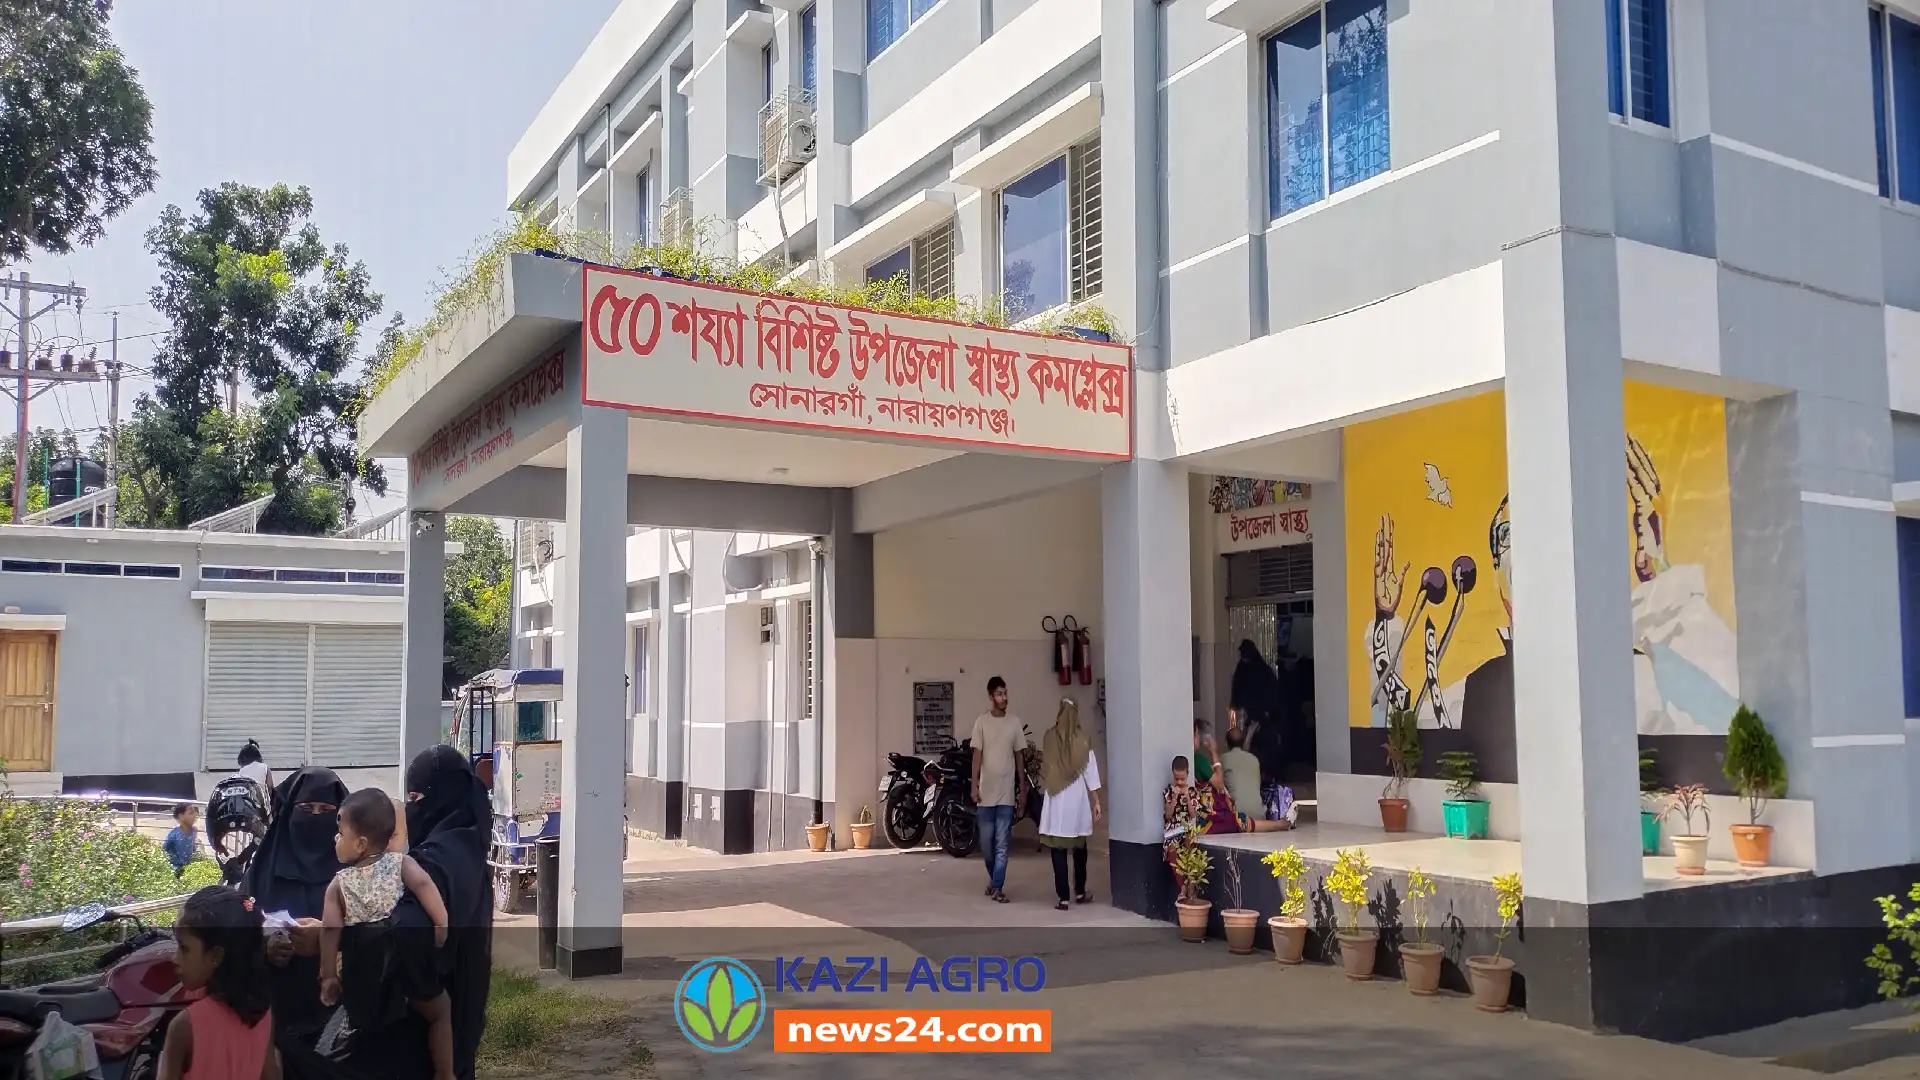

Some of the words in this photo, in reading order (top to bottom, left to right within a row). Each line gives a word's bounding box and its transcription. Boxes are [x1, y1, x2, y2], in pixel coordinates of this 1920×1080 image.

[589, 284, 662, 356] ৫০
[664, 297, 750, 369] শয্যা
[753, 299, 843, 379] বিশিষ্ট
[847, 310, 960, 394] উপজেলা
[965, 336, 1021, 405] স্বাস্থ্য
[1025, 352, 1128, 418] কমপ্লেক্স
[876, 393, 1016, 439] নারায়ণগঞ্জ।
[1230, 512, 1276, 543] উপজেলা
[1279, 508, 1309, 534] স্বাস্থ্য
